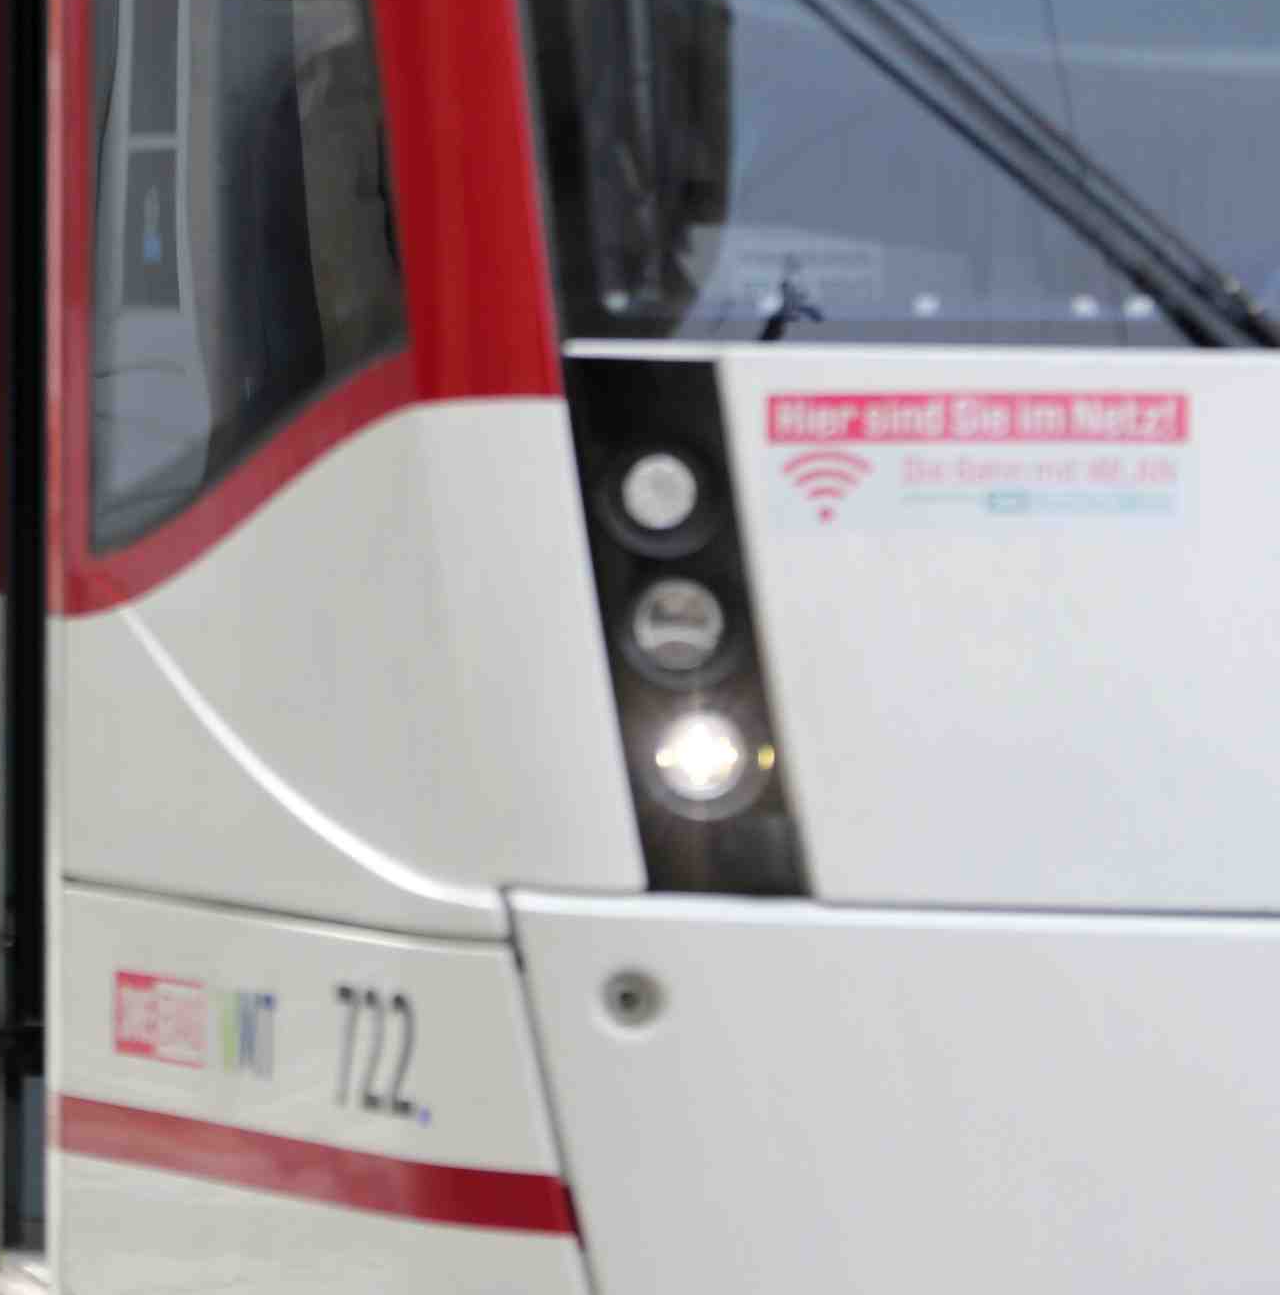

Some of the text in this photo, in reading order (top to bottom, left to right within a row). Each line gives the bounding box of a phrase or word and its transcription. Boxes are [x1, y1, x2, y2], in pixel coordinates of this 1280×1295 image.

[776, 399, 1180, 437] Hier sind Sie im Netz!
[334, 984, 416, 1116] 722
